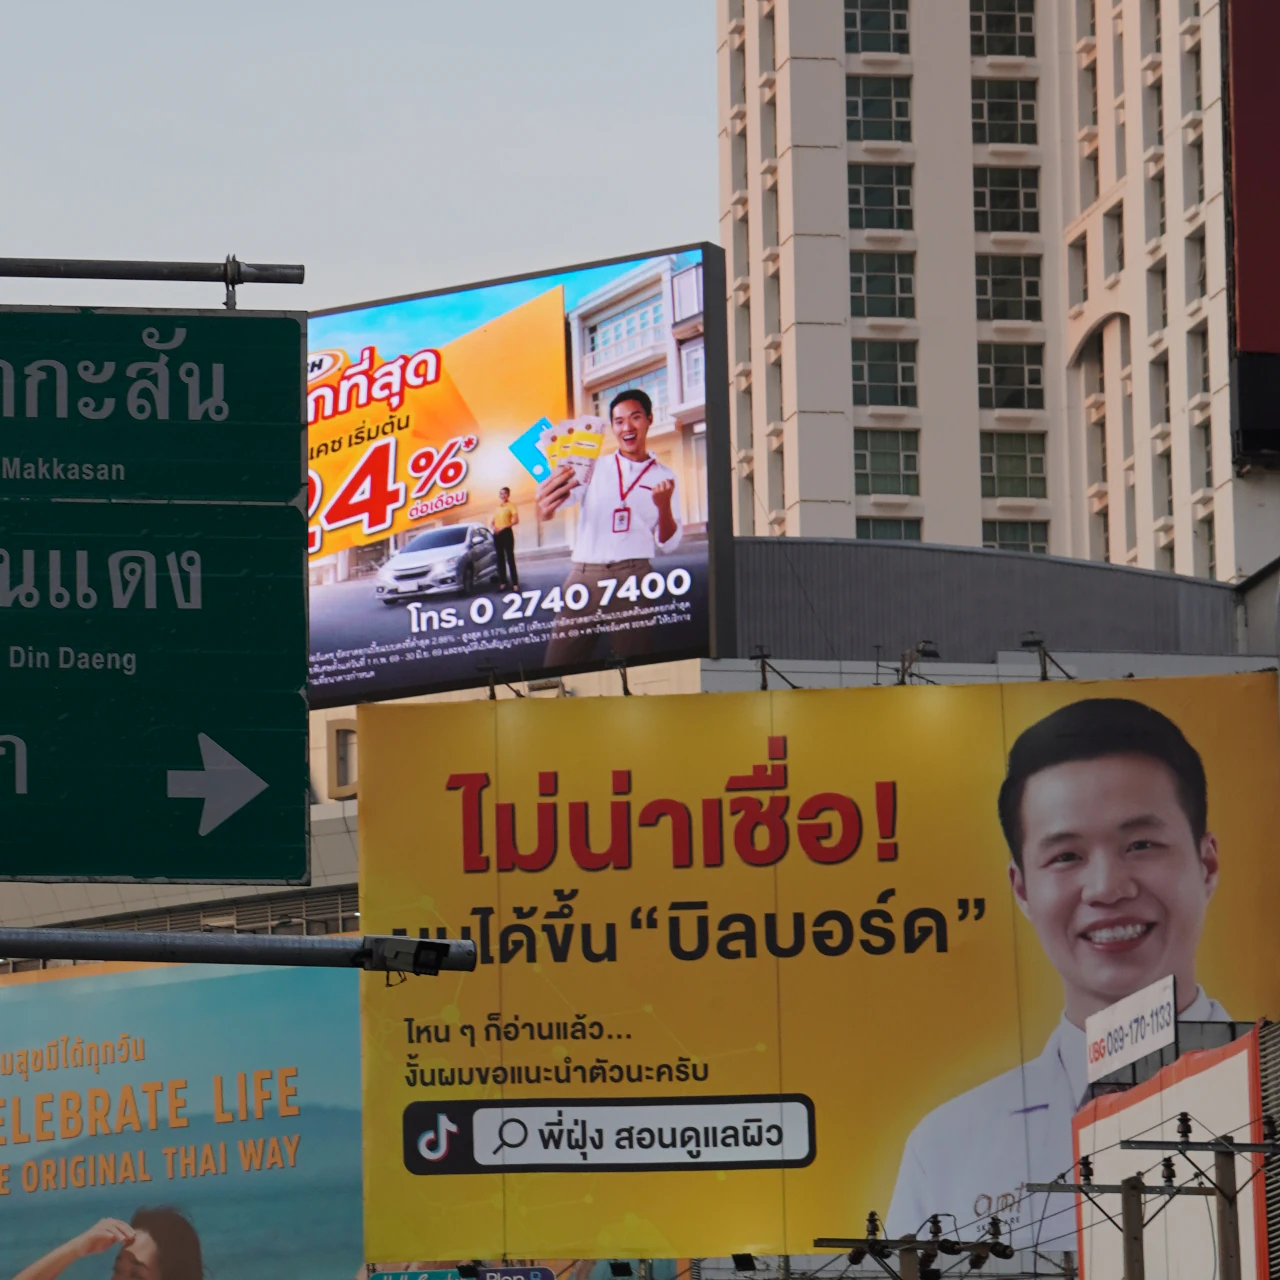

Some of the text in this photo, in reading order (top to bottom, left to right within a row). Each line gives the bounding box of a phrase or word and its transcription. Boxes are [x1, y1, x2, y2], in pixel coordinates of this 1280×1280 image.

[348, 415, 410, 448] เริ่มต้น
[1, 457, 125, 481] Makkasan
[409, 491, 467, 520] ต่อเดือน
[407, 568, 692, 633] โทร. 0 2740 7400
[9, 646, 137, 675] Din Daeng
[445, 734, 899, 874] ไม่น่าเชื่อ!
[393, 888, 618, 966] ได้ขึ้น
[404, 1011, 633, 1048] ไหน ๆ ก็อ่านแล้ว...
[1088, 1001, 1172, 1065] UBG 089-170-1133
[404, 1053, 710, 1088] งั้นผมขอแนะนำตัวนะครับ
[213, 1067, 301, 1125] LIFE
[615, 1118, 784, 1159] สอนดูแลผิว
[22, 1151, 152, 1193] ORIGINAL
[164, 1142, 227, 1180] THAI
[239, 1134, 301, 1173] WAY
